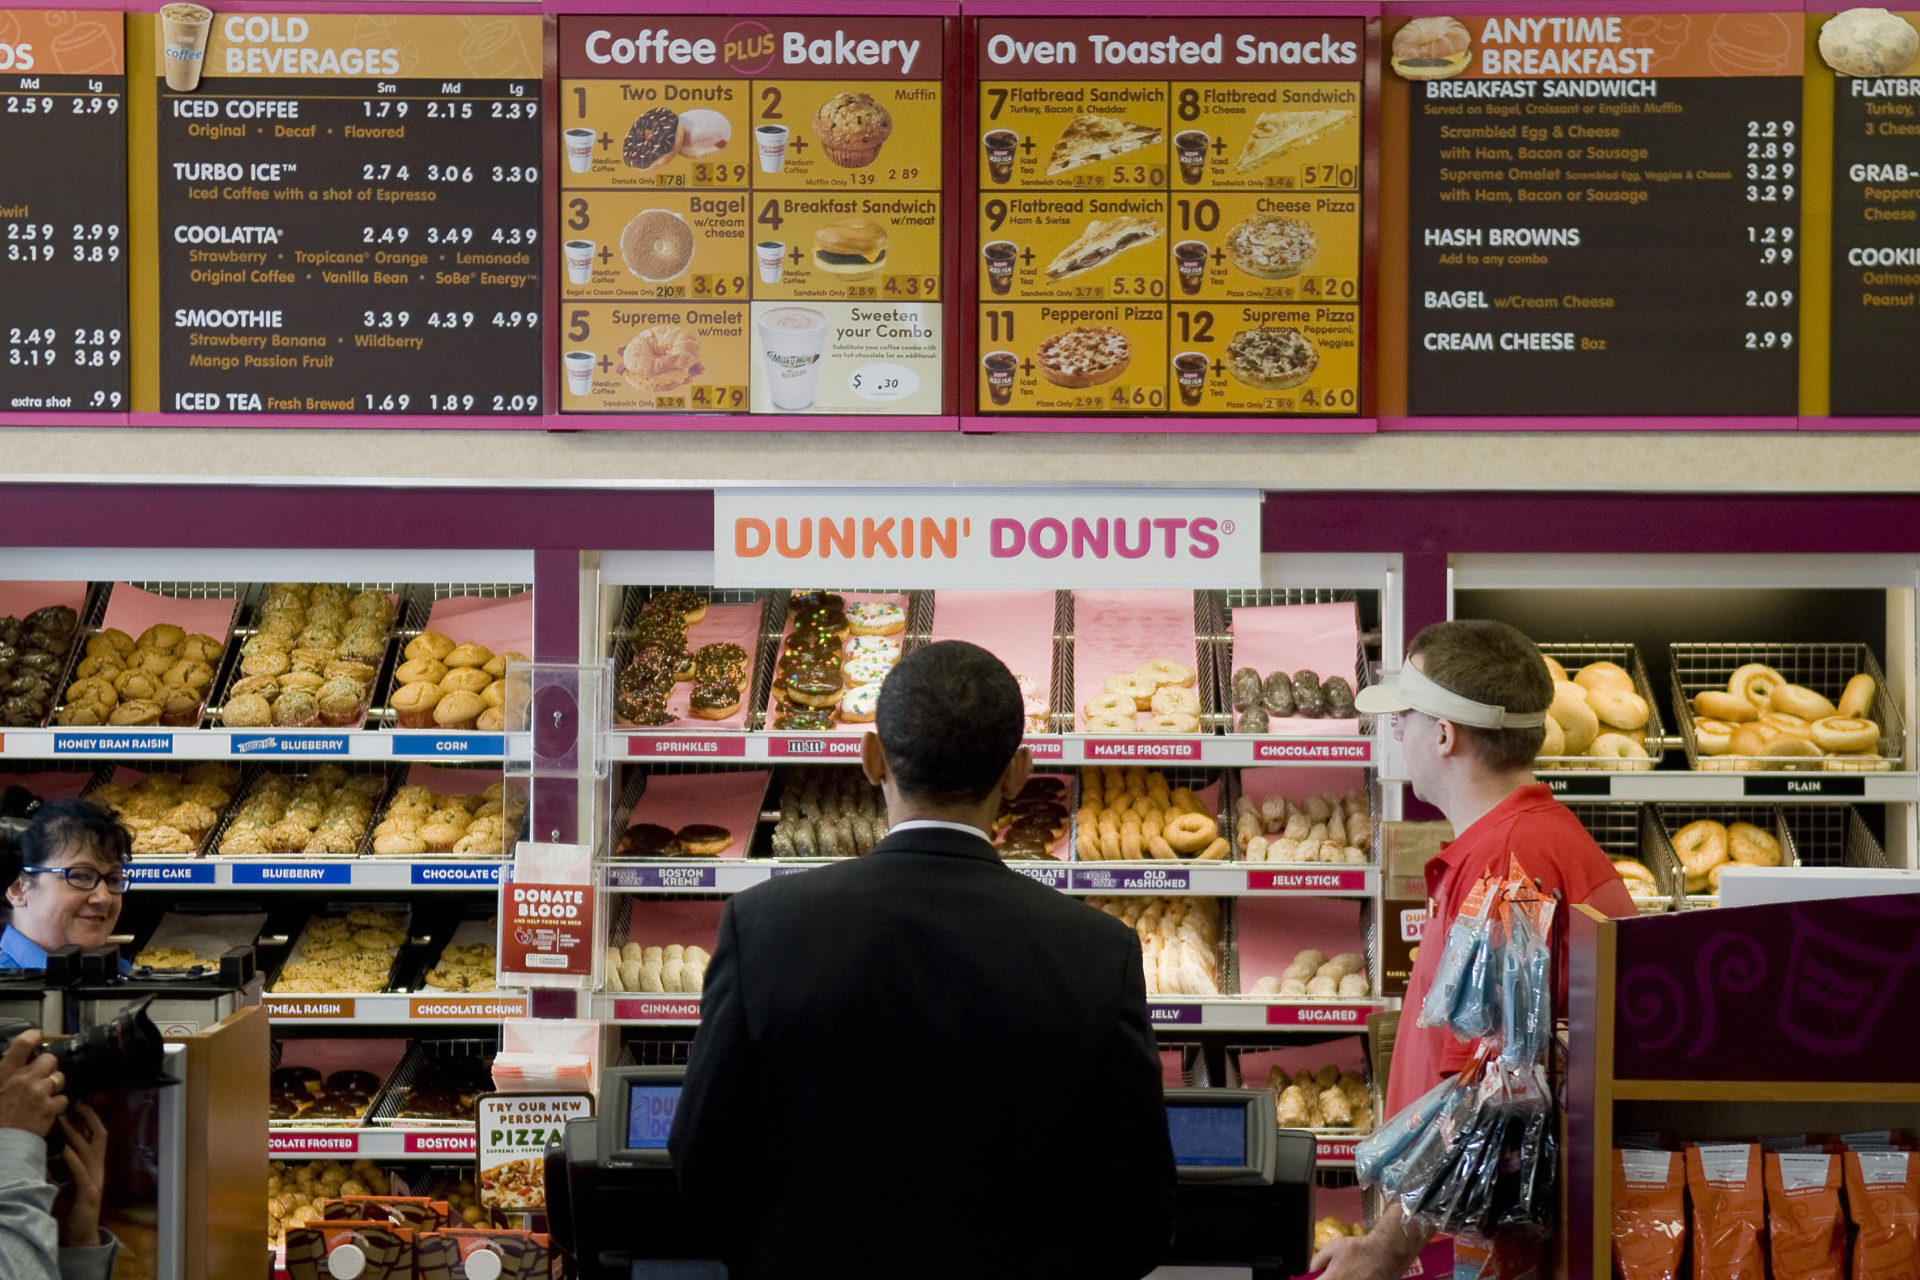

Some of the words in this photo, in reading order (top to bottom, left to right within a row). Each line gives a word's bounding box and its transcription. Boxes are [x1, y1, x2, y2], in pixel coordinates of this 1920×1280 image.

[224, 16, 309, 43] COLD
[1481, 16, 1622, 43] ANYTIME
[585, 29, 716, 64] Coffee
[724, 33, 775, 64] PLUS
[783, 30, 920, 74] Bakery
[988, 34, 1076, 64] Oven
[1088, 33, 1222, 64] Toasted
[1236, 33, 1357, 64] Snacks
[226, 47, 400, 75] BEVERAGES
[1483, 48, 1654, 75] BREAKFAST
[20, 78, 39, 89] Md
[88, 79, 102, 93] Lg
[378, 82, 396, 93] Sm
[442, 83, 461, 93] Md
[510, 83, 523, 97] Lg
[1427, 80, 1537, 98] BREAKFAST
[1543, 79, 1656, 98] SANDWICH
[573, 87, 586, 118] 1
[620, 85, 657, 101] Two
[664, 84, 733, 101] Donuts
[895, 89, 936, 101] Muffin
[8, 96, 53, 113] 2.59
[73, 98, 118, 114] 2.99
[174, 100, 219, 118] ICED
[226, 100, 298, 118] COFFEE
[364, 101, 408, 117] 1.79
[427, 102, 472, 118] 2.15
[492, 102, 537, 119] 2.39
[762, 87, 782, 119] 2
[987, 89, 1008, 120] 7
[1011, 87, 1084, 102] Flatbread
[1090, 87, 1164, 102] Sandwich
[1010, 104, 1041, 115] Turkey,
[1044, 105, 1073, 113] Bacon
[1087, 105, 1126, 113] Cheddar
[187, 123, 246, 140] Original
[275, 125, 316, 137] Decaf
[344, 125, 404, 138] Flavored
[1441, 125, 1517, 138] Scrambled
[1522, 125, 1548, 142] Egg
[1552, 125, 1564, 138] &
[1568, 125, 1620, 138] Cheese
[1748, 121, 1795, 137] 2.29
[173, 163, 243, 181] TURBO
[363, 164, 409, 181] 2.74
[428, 165, 473, 182] 3.06
[492, 166, 538, 183] 3.30
[189, 186, 218, 200] Iced
[223, 186, 270, 200] Coffee
[273, 187, 304, 200] with
[308, 190, 318, 200] a
[323, 188, 353, 200] shot
[357, 187, 372, 201] of
[376, 188, 437, 204] Espresso
[568, 198, 589, 230] 3
[690, 196, 745, 217] Bagel
[758, 199, 784, 230] 4
[784, 199, 857, 213] Breakfast
[863, 199, 936, 213] Sandwich
[891, 216, 935, 225] w/meat
[985, 199, 1007, 232] 9
[1010, 199, 1083, 213] Flatbread
[1090, 199, 1163, 213] Sandwich
[1177, 199, 1220, 232] 10
[1257, 198, 1311, 212] Cheese
[1316, 198, 1356, 212] Pizza
[694, 217, 744, 228] w/cream
[363, 227, 408, 243] 2.49
[428, 228, 472, 243] 3.49
[491, 228, 537, 244] 4.39
[705, 227, 745, 238] cheese
[1425, 228, 1481, 246] HASH
[1489, 228, 1580, 246] BROWNS
[1748, 227, 1794, 243] 1.29
[1439, 253, 1462, 264] Add
[1466, 254, 1477, 264] to
[1480, 256, 1505, 266] any
[1508, 253, 1548, 264] combo
[1425, 291, 1488, 309] BAGEL
[1494, 295, 1559, 308] w/Cream
[1563, 295, 1614, 308] Cheese
[1746, 290, 1793, 307] 2.09
[1862, 293, 1915, 306] Peanut
[175, 309, 282, 327] SMOOTHIE
[851, 308, 917, 321] Sweeten
[568, 310, 590, 342] 5
[612, 310, 680, 327] Supreme
[686, 310, 742, 324] Omelet
[986, 311, 1014, 341] 11
[1042, 307, 1118, 324] Pepperoni
[1125, 306, 1163, 320] Pizza
[837, 329, 871, 341] your
[876, 324, 932, 338] Combo
[1424, 333, 1493, 350] CREAM
[1500, 332, 1574, 350] CHEESE
[1581, 337, 1606, 350] 8oz
[1745, 332, 1792, 348] 2.99
[190, 354, 240, 371] Mango
[244, 354, 297, 367] Passion
[303, 355, 334, 368] Fruit
[11, 396, 42, 407] extra
[46, 396, 71, 407] shot
[176, 392, 220, 410] ICED
[226, 393, 262, 411] TEA
[267, 397, 302, 410] Fresh
[305, 397, 355, 410] Brewed
[735, 517, 970, 558] DUNKIN'
[59, 740, 96, 749] HONEY
[99, 738, 129, 748] BRAN
[132, 739, 169, 748] RAISIN
[281, 741, 343, 751] BLUEBERRY
[436, 741, 467, 751] CORN
[656, 742, 717, 752] SPRINKLES
[1095, 745, 1135, 755] MAPLE
[1137, 745, 1192, 755] FROSTED
[1261, 746, 1329, 756] CHOCOLATE
[1331, 746, 1364, 756] STICK
[1788, 781, 1820, 791] PLAIN
[162, 869, 191, 878] CAKE
[263, 869, 324, 879] BLUEBERRY
[423, 868, 496, 880] CHOCOLATE
[658, 869, 703, 878] BOSTON
[1143, 870, 1166, 879] OLD
[1272, 875, 1303, 886] JELLY
[1305, 875, 1339, 886] STICK
[662, 877, 699, 886] KREME
[1124, 878, 1186, 888] FASHIONED
[514, 889, 583, 904] DONATE
[518, 904, 577, 918] BLOOD
[304, 1004, 340, 1014] RAISIN
[418, 1005, 483, 1015] CHOCOLATE
[485, 1005, 522, 1015] CHUNK
[1151, 1010, 1179, 1019] JELLY
[1298, 1009, 1357, 1021] SUGARED
[488, 1103, 512, 1112] TRY
[518, 1102, 546, 1112] OUR
[552, 1102, 581, 1111] NEW
[500, 1114, 567, 1124] PERSONAL
[307, 1139, 352, 1148] FROSTED
[417, 1138, 467, 1149] BOSTON
